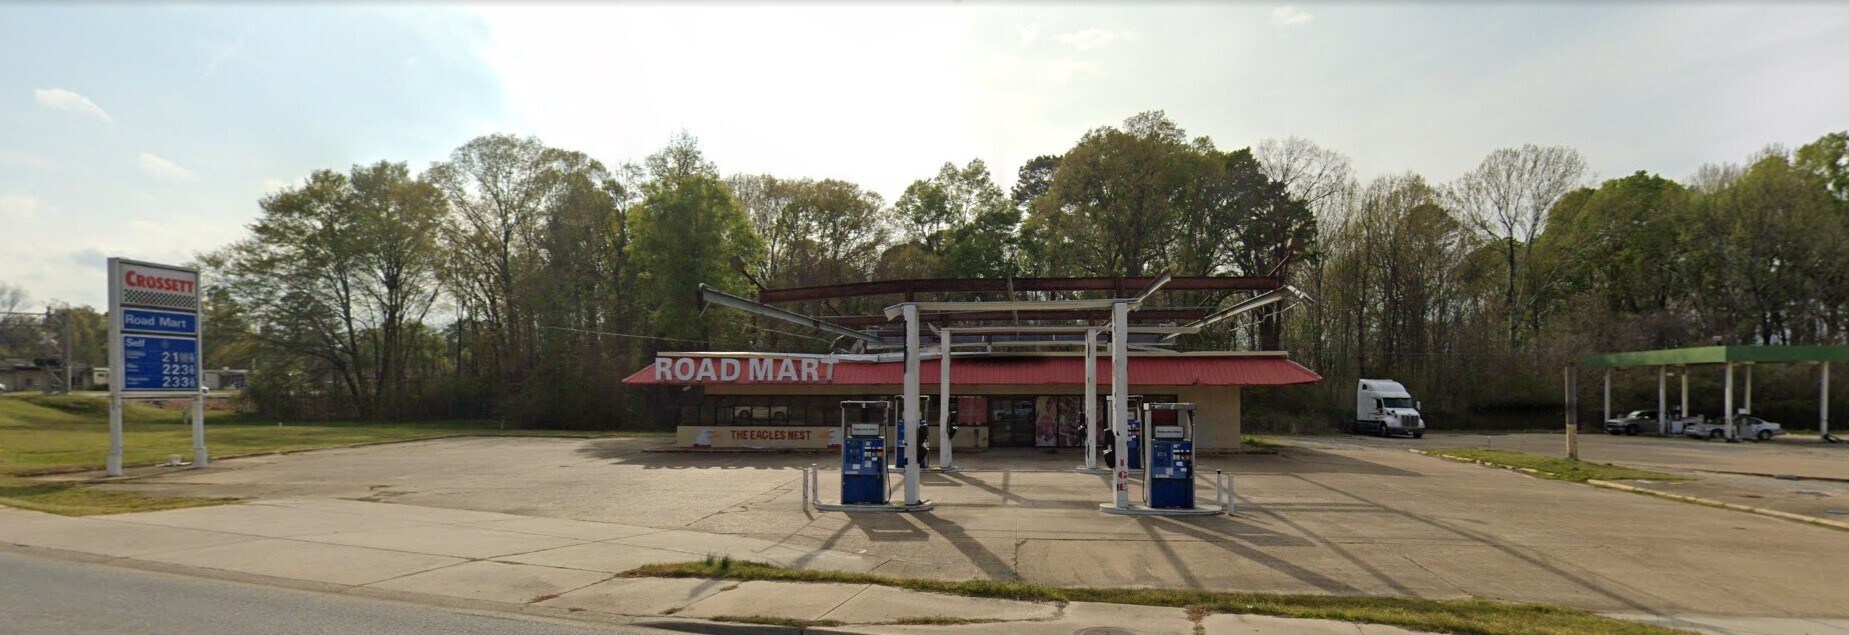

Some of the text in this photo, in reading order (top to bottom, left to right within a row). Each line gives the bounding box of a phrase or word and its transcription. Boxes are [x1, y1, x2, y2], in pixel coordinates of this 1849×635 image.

[126, 271, 194, 293] CROSSETT
[125, 314, 187, 328] Road Mart
[126, 338, 145, 347] Self
[655, 357, 839, 382] ROAD MART
[731, 430, 812, 440] THE EAGLES NEST
